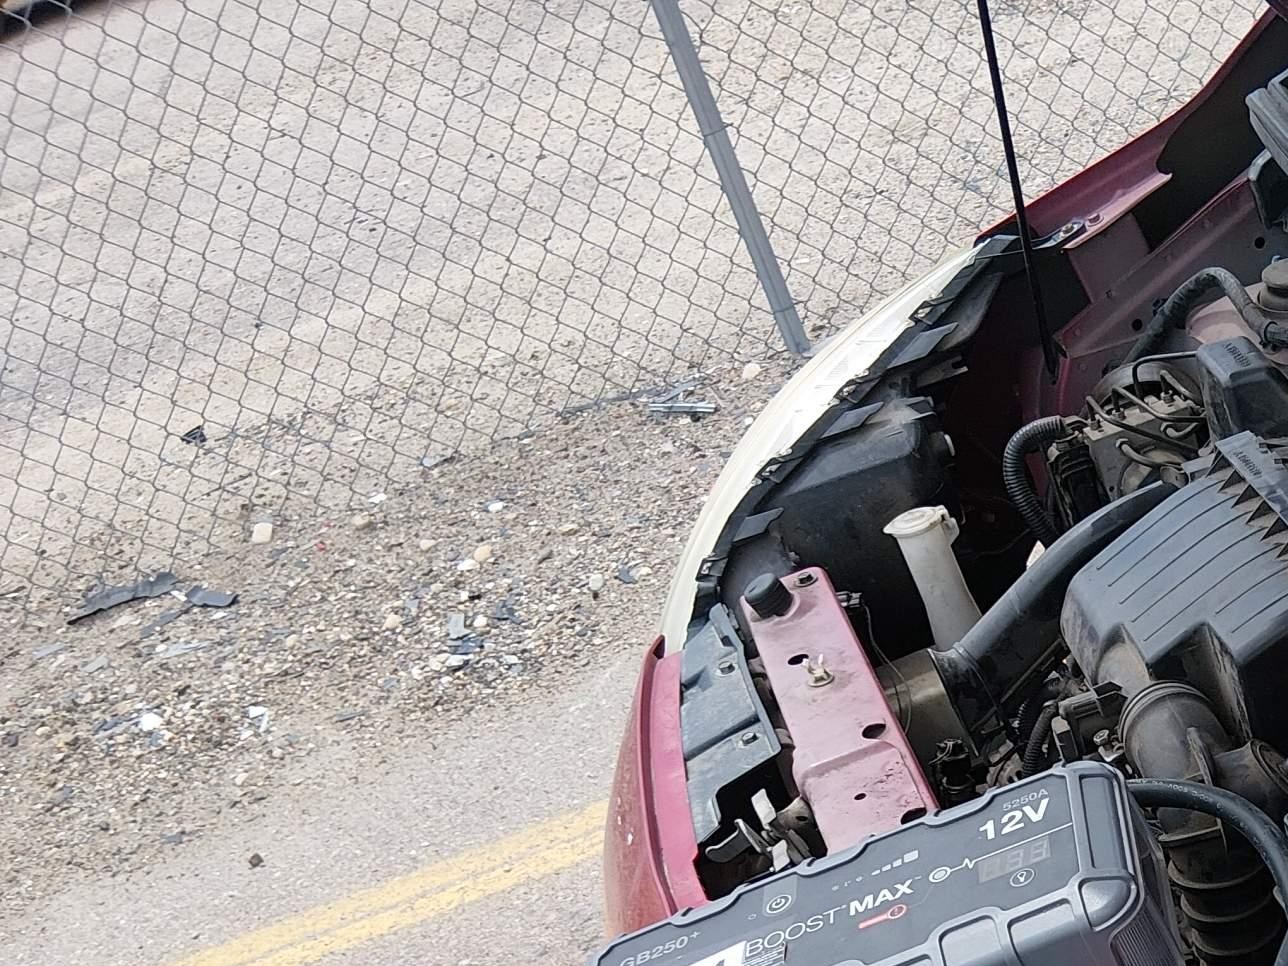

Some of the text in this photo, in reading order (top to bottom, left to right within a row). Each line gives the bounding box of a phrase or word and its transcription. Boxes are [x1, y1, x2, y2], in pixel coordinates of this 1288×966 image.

[979, 798, 1049, 841] 12V
[1003, 788, 1049, 811] 5250A
[745, 879, 914, 958] BOOST MAX
